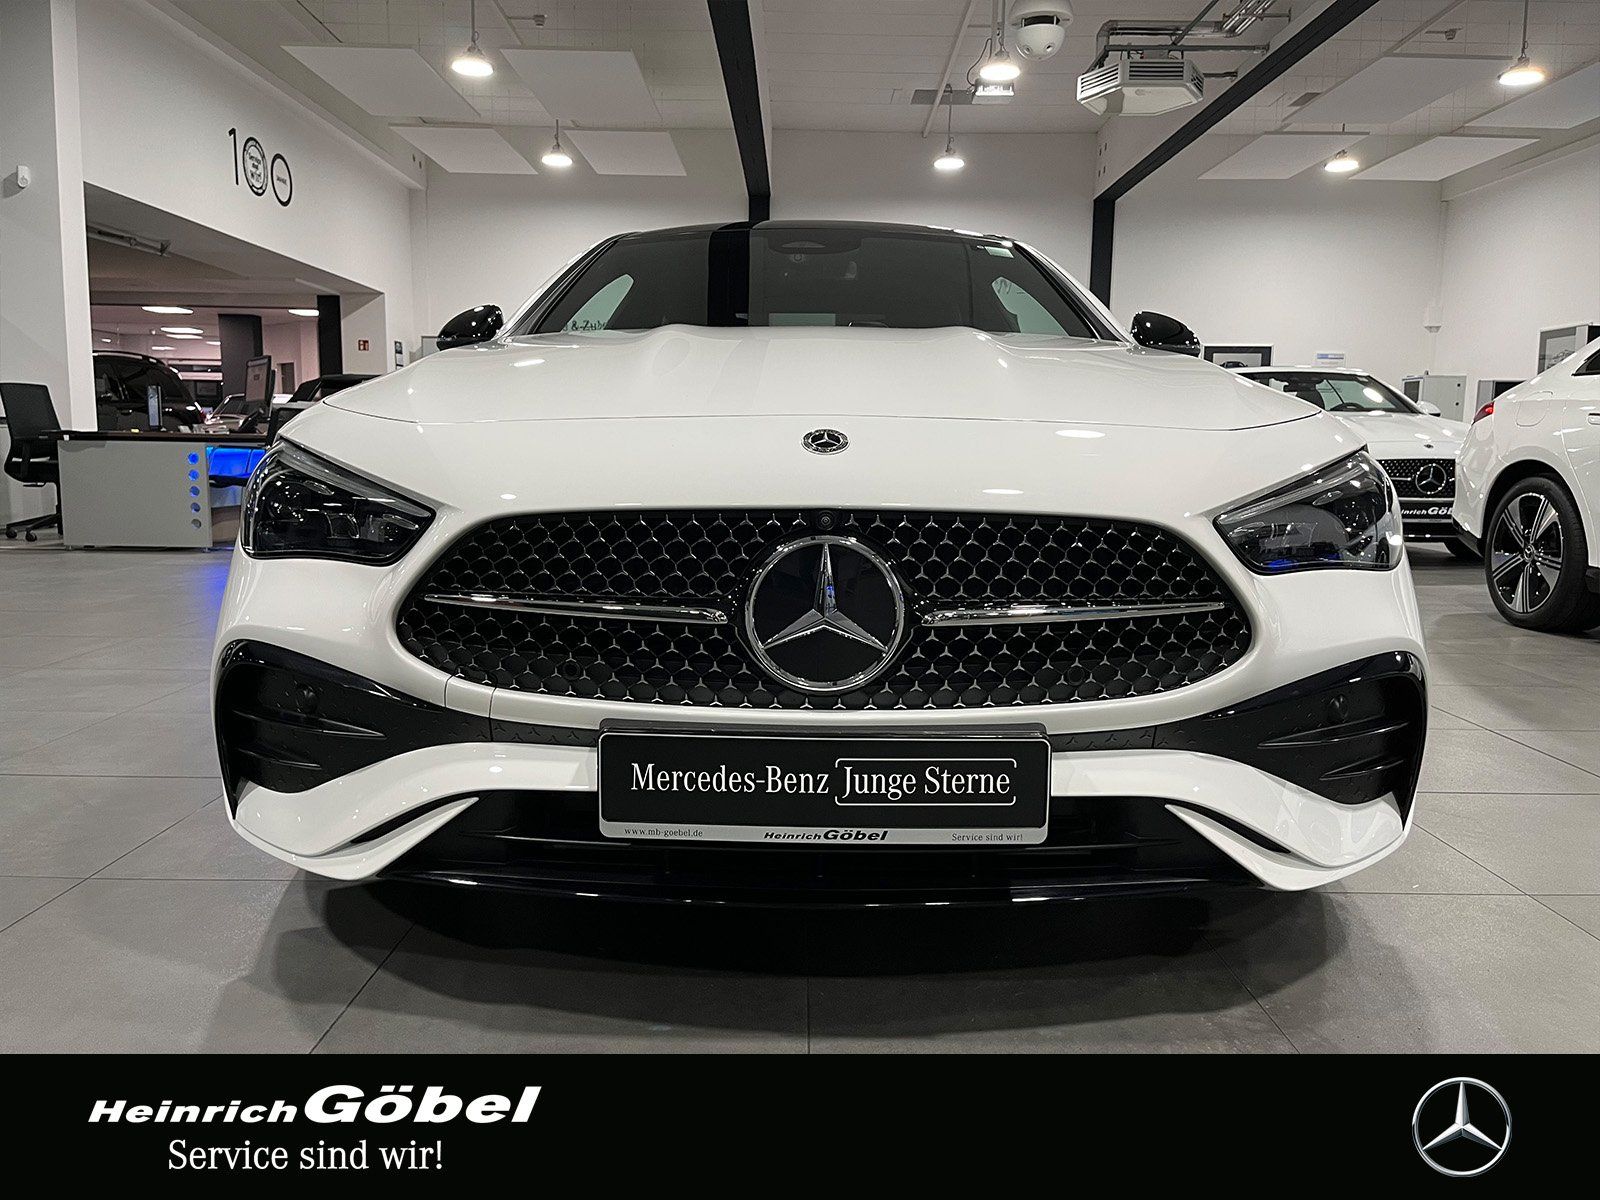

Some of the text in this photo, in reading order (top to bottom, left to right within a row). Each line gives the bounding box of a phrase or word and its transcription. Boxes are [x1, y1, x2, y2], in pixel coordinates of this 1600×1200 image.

[228, 127, 293, 207] 100
[630, 762, 1010, 800] Mercedes-Benz Junge Sterne
[624, 828, 704, 838] www.mb-goebel.de
[763, 829, 889, 842] Heinrich Göbel
[951, 833, 1024, 841] Service sind wir!
